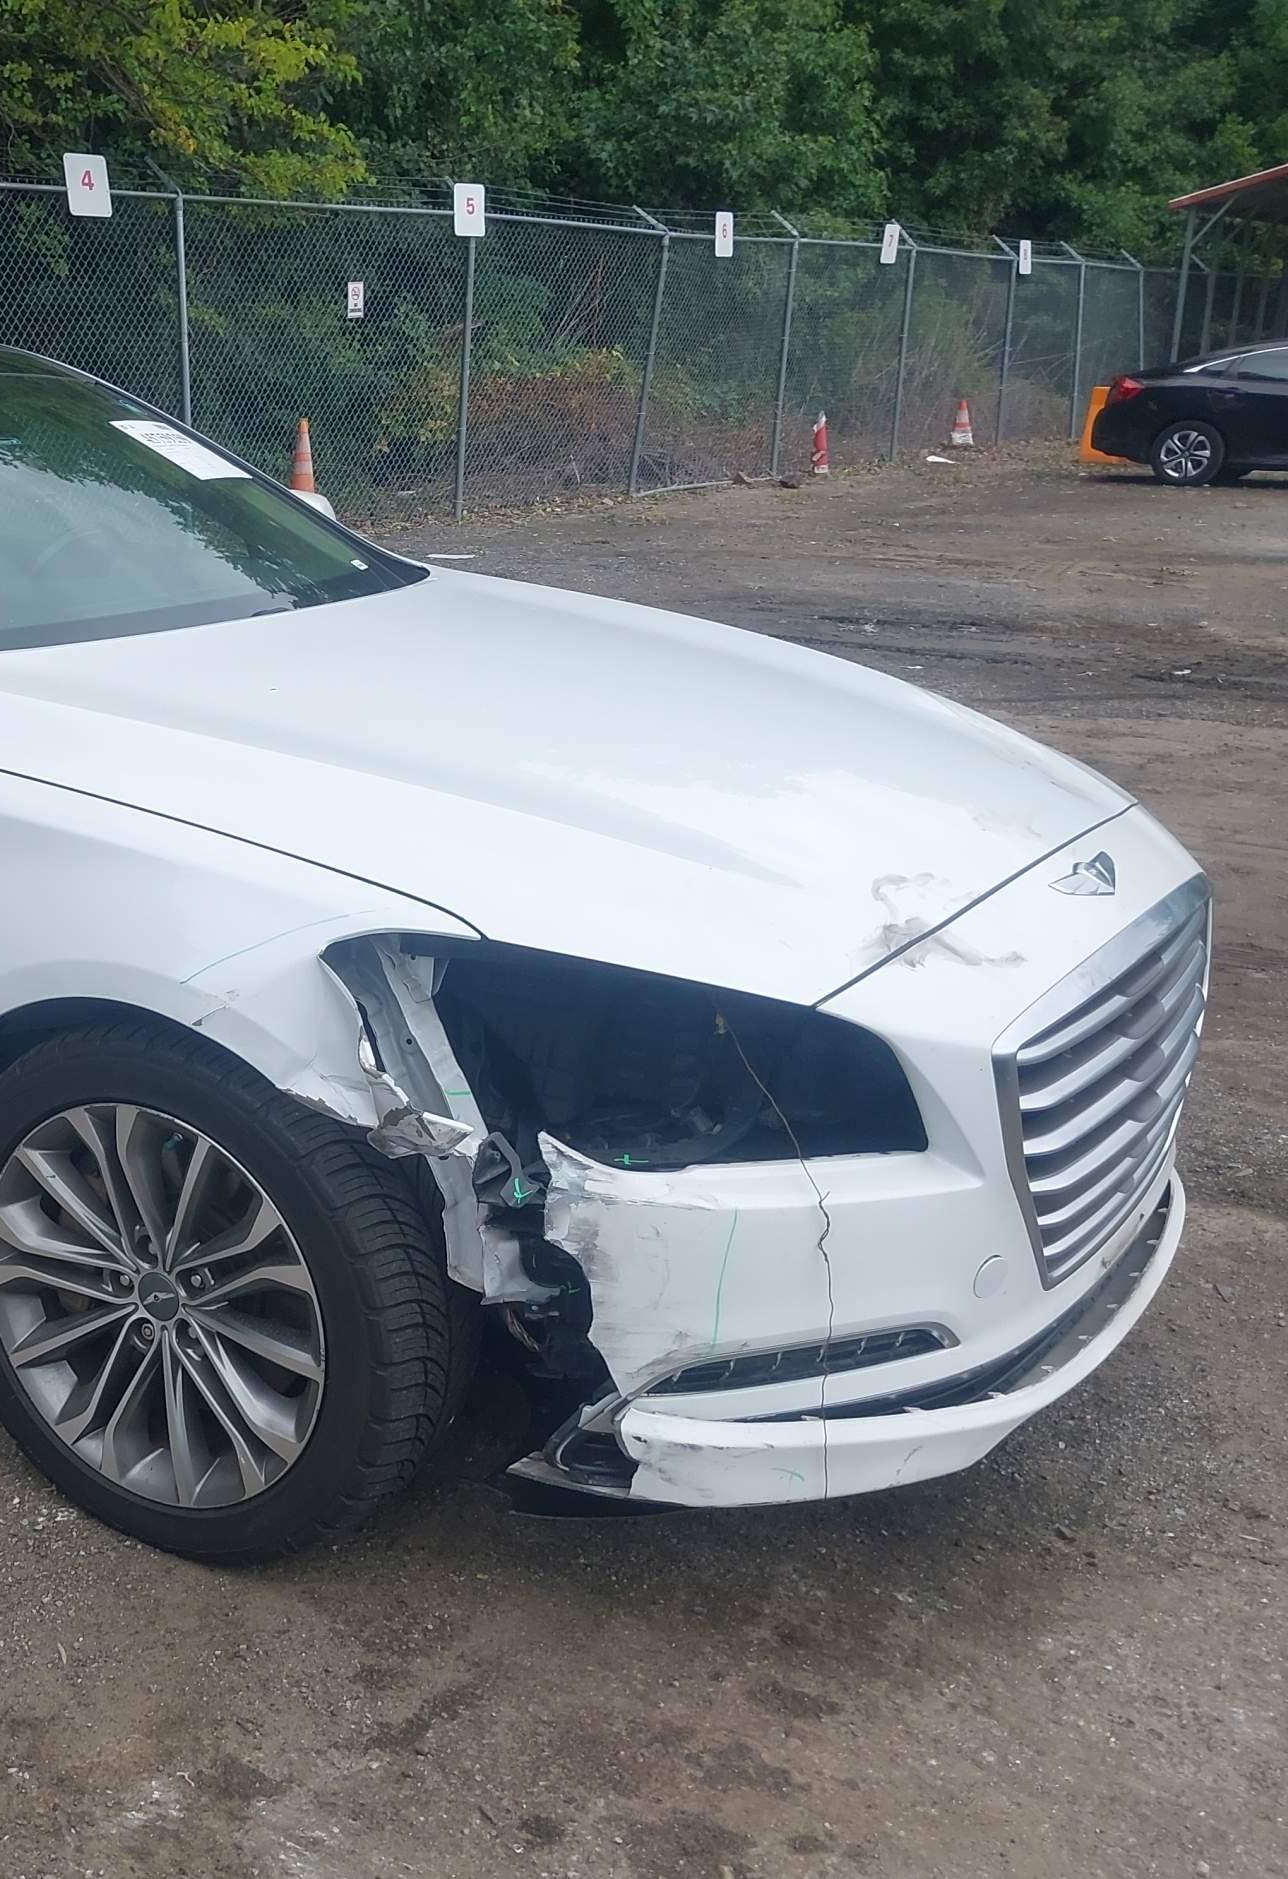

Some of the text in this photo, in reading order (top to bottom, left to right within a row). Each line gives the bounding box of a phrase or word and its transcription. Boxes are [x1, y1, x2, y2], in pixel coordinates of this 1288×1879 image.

[81, 169, 95, 191] 4
[466, 197, 475, 215] 5
[722, 223, 728, 239] 6
